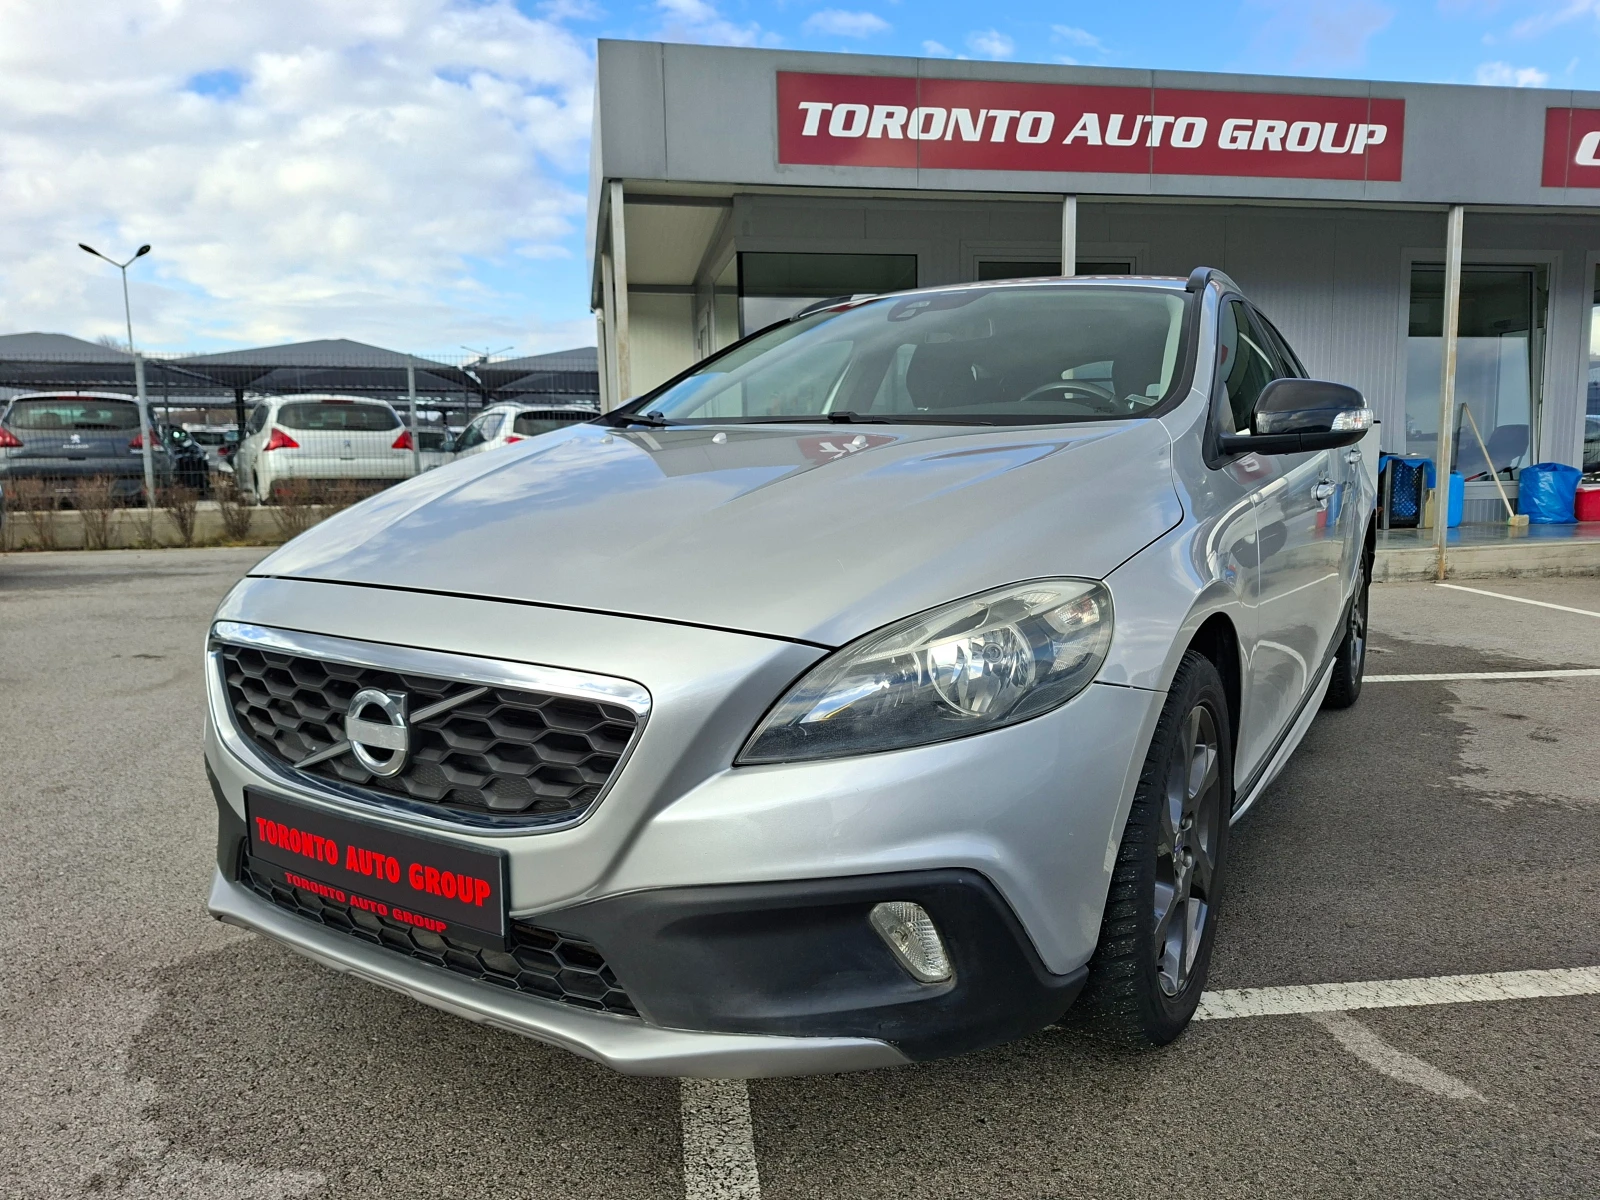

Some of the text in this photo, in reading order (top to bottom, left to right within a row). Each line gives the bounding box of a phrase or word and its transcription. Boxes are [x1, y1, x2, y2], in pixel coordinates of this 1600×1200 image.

[798, 101, 1388, 155] TORONTO AUTO GROUP
[255, 816, 491, 907] TORONTO AUTO GROUP
[284, 872, 447, 933] TORONTO AUTO GROUP
